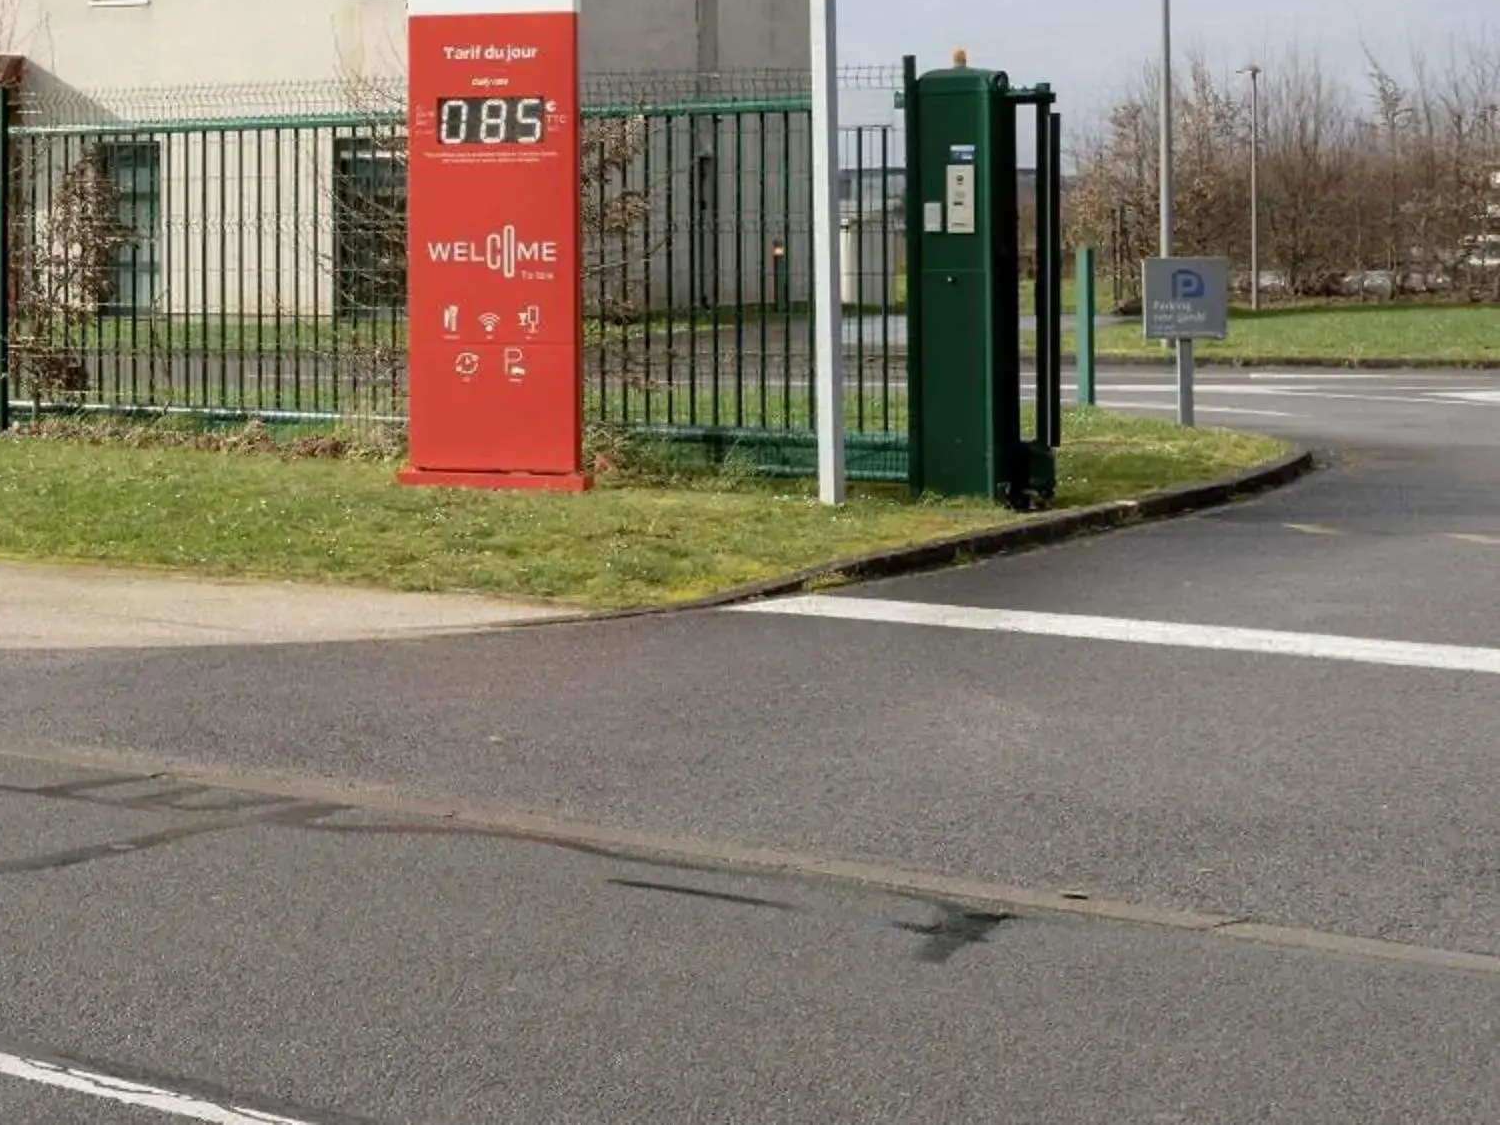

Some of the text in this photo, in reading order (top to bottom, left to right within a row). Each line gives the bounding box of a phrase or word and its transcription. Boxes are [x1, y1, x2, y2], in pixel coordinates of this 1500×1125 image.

[443, 44, 538, 62] Tarif du jour
[440, 98, 542, 145] 085
[544, 114, 568, 124] TTC
[427, 224, 557, 278] WELCOME
